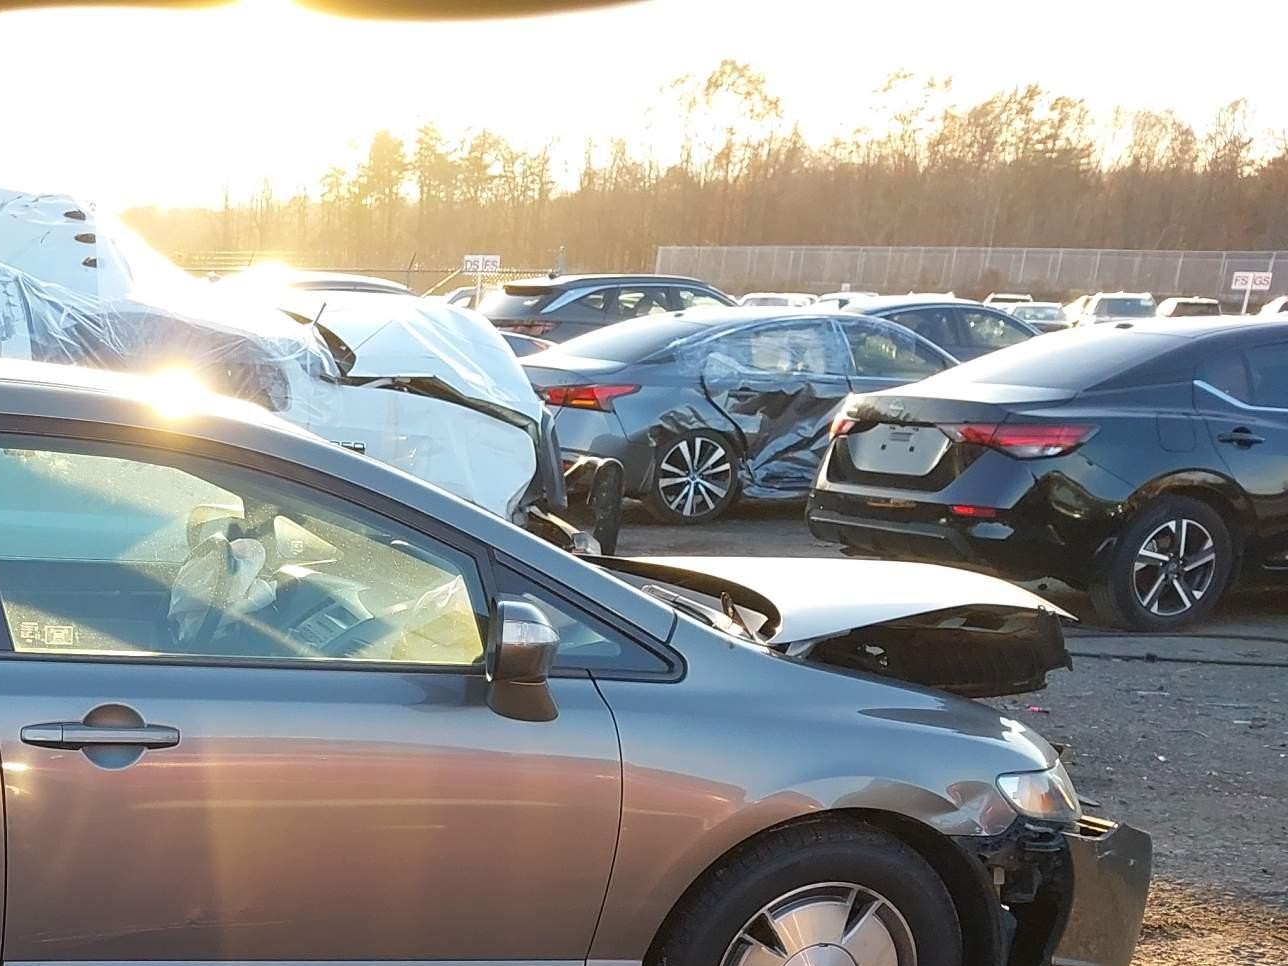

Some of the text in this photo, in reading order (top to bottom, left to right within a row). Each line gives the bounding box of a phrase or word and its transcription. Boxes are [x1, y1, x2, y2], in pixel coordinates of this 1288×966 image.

[465, 259, 480, 271] DS
[484, 259, 498, 271] FS
[329, 440, 365, 455] 50
